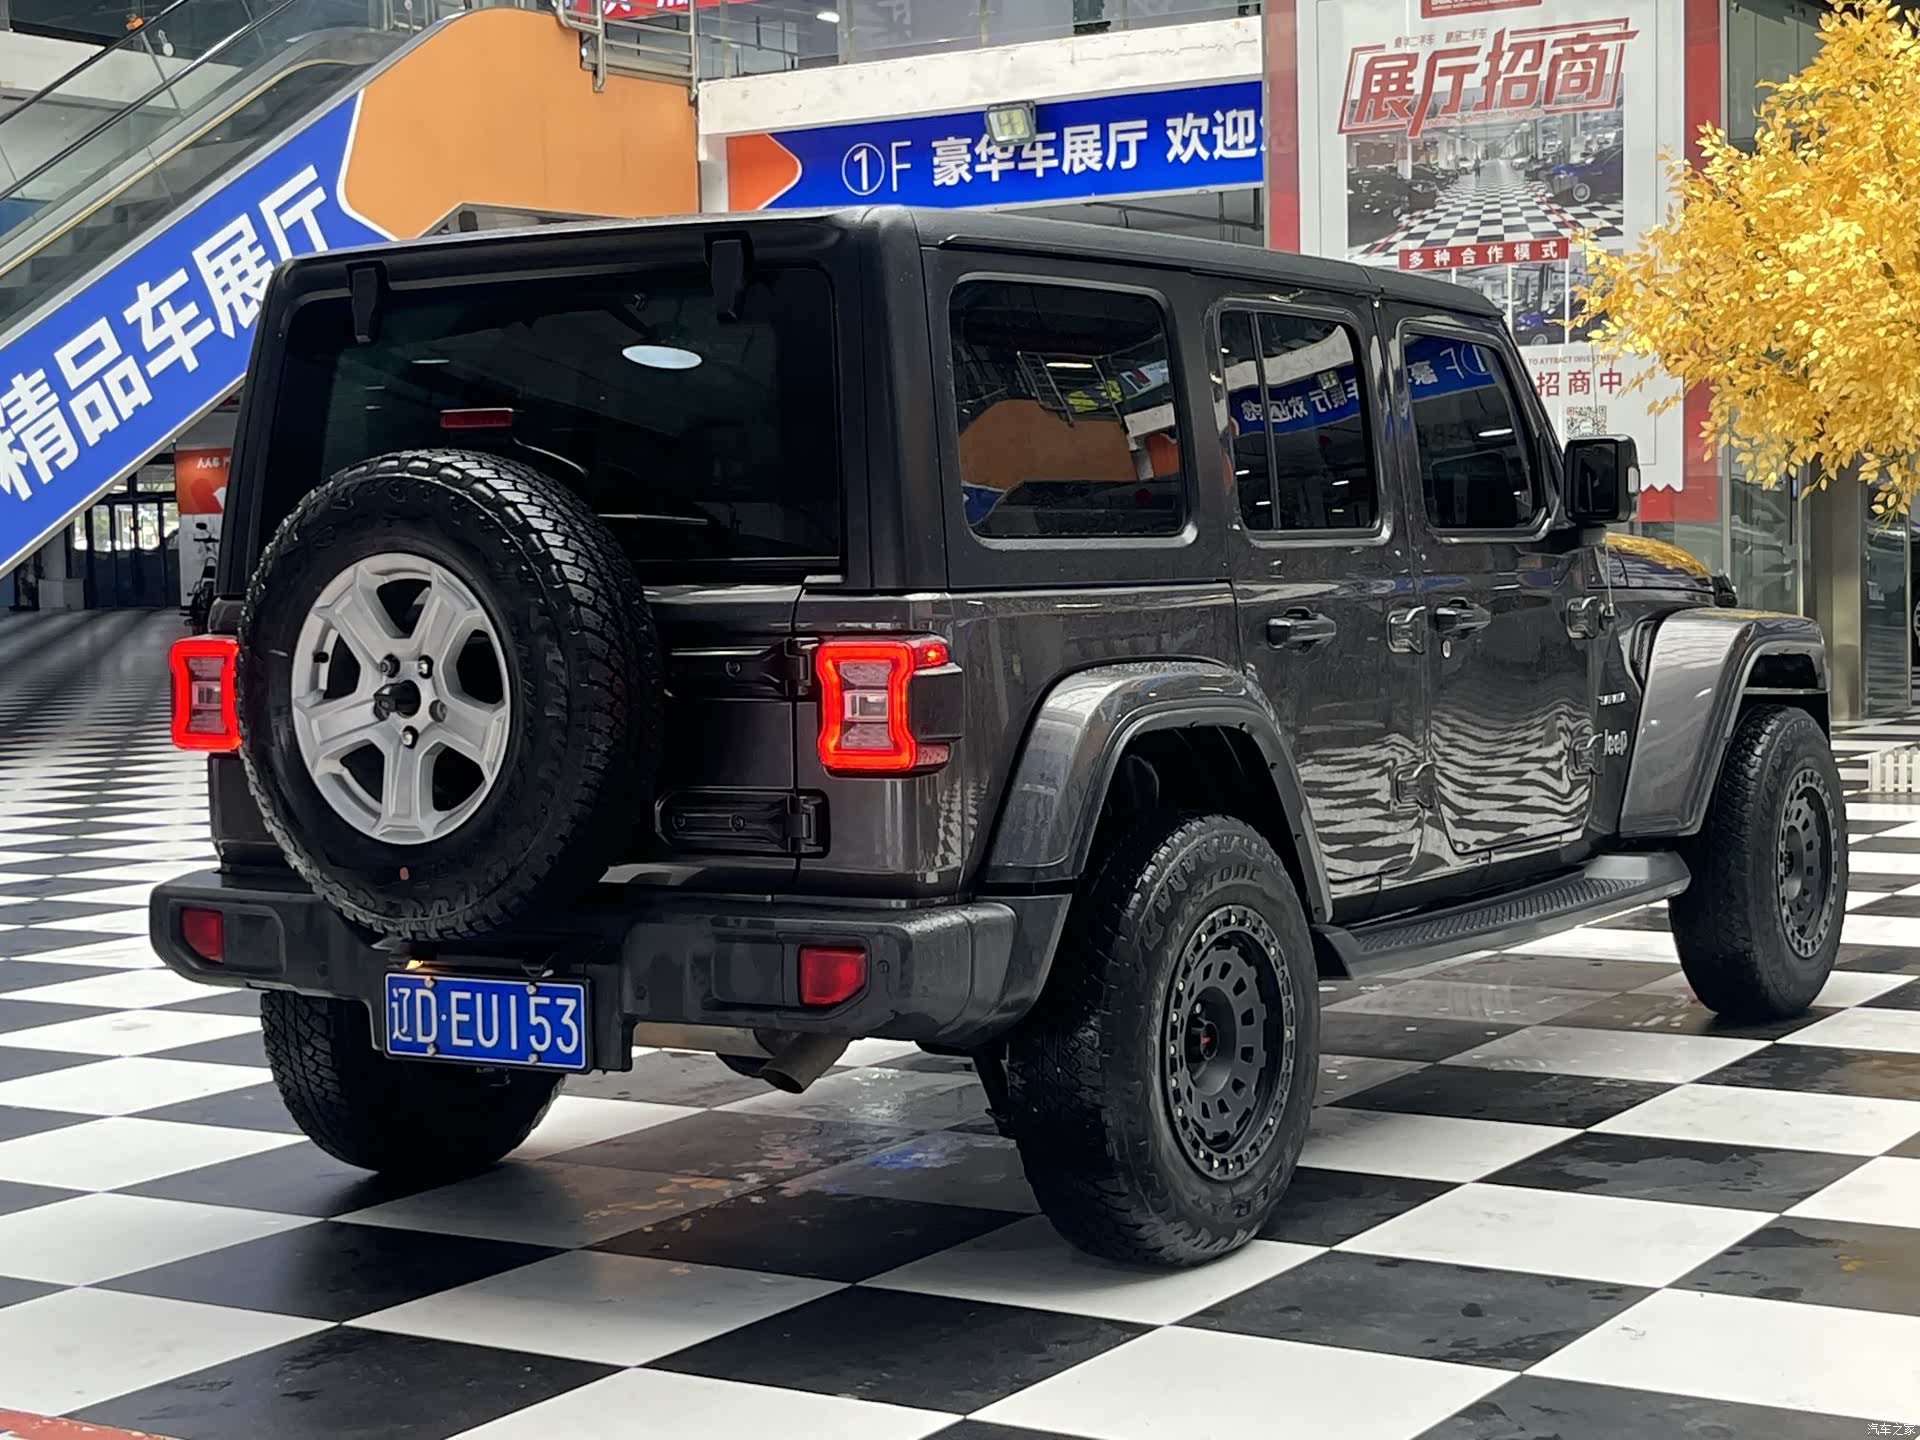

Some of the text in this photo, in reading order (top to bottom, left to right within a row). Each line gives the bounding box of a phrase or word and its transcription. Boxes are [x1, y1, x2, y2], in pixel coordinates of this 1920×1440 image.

[1354, 27, 1639, 137] 展厅招商
[931, 119, 1148, 187] 豪华车展厅
[1166, 108, 1266, 165] 欢迎
[1408, 242, 1559, 269] 多种合作模式
[0, 164, 329, 502] 精品车展厅
[1539, 355, 1573, 365] ATTRACT
[1536, 368, 1622, 397] 招商中
[1602, 728, 1628, 757] Jeep
